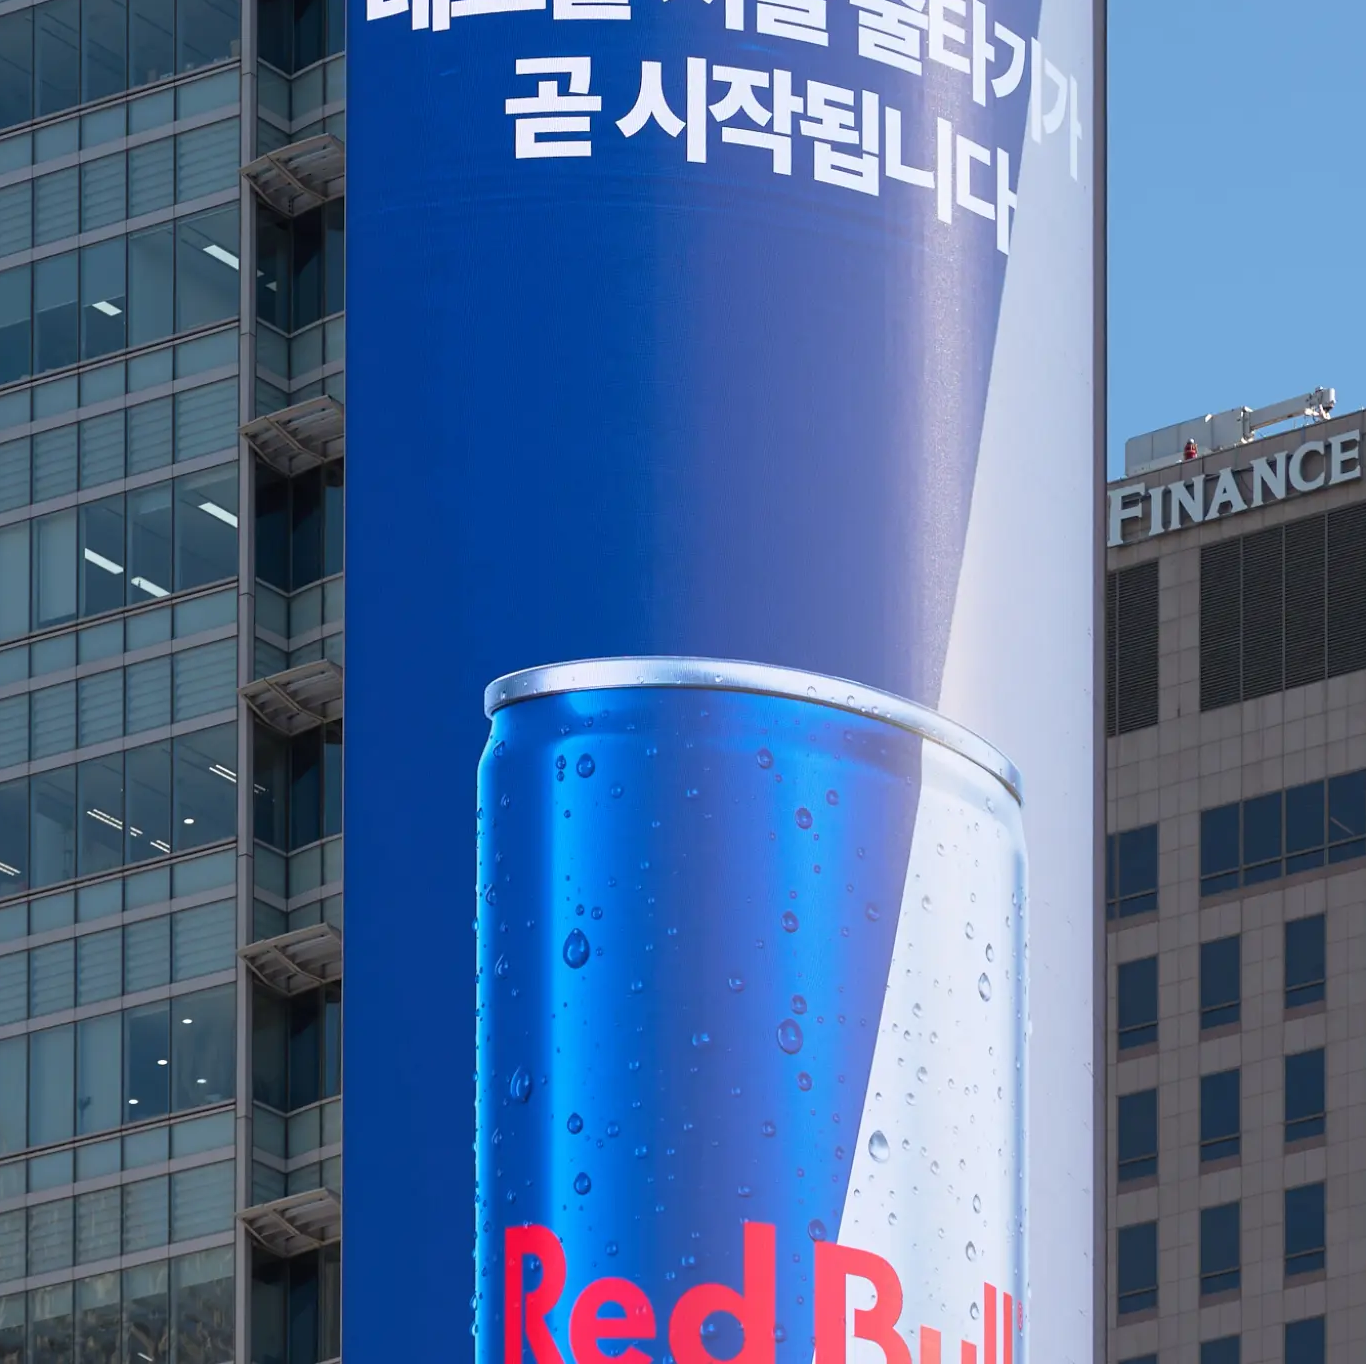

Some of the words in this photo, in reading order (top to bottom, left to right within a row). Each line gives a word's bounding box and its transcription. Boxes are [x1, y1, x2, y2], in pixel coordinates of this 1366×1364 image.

[505, 56, 602, 160] 곧
[616, 57, 1020, 257] 시작됩니다
[1107, 429, 1362, 547] FINANCE
[505, 1222, 776, 1364] Red
